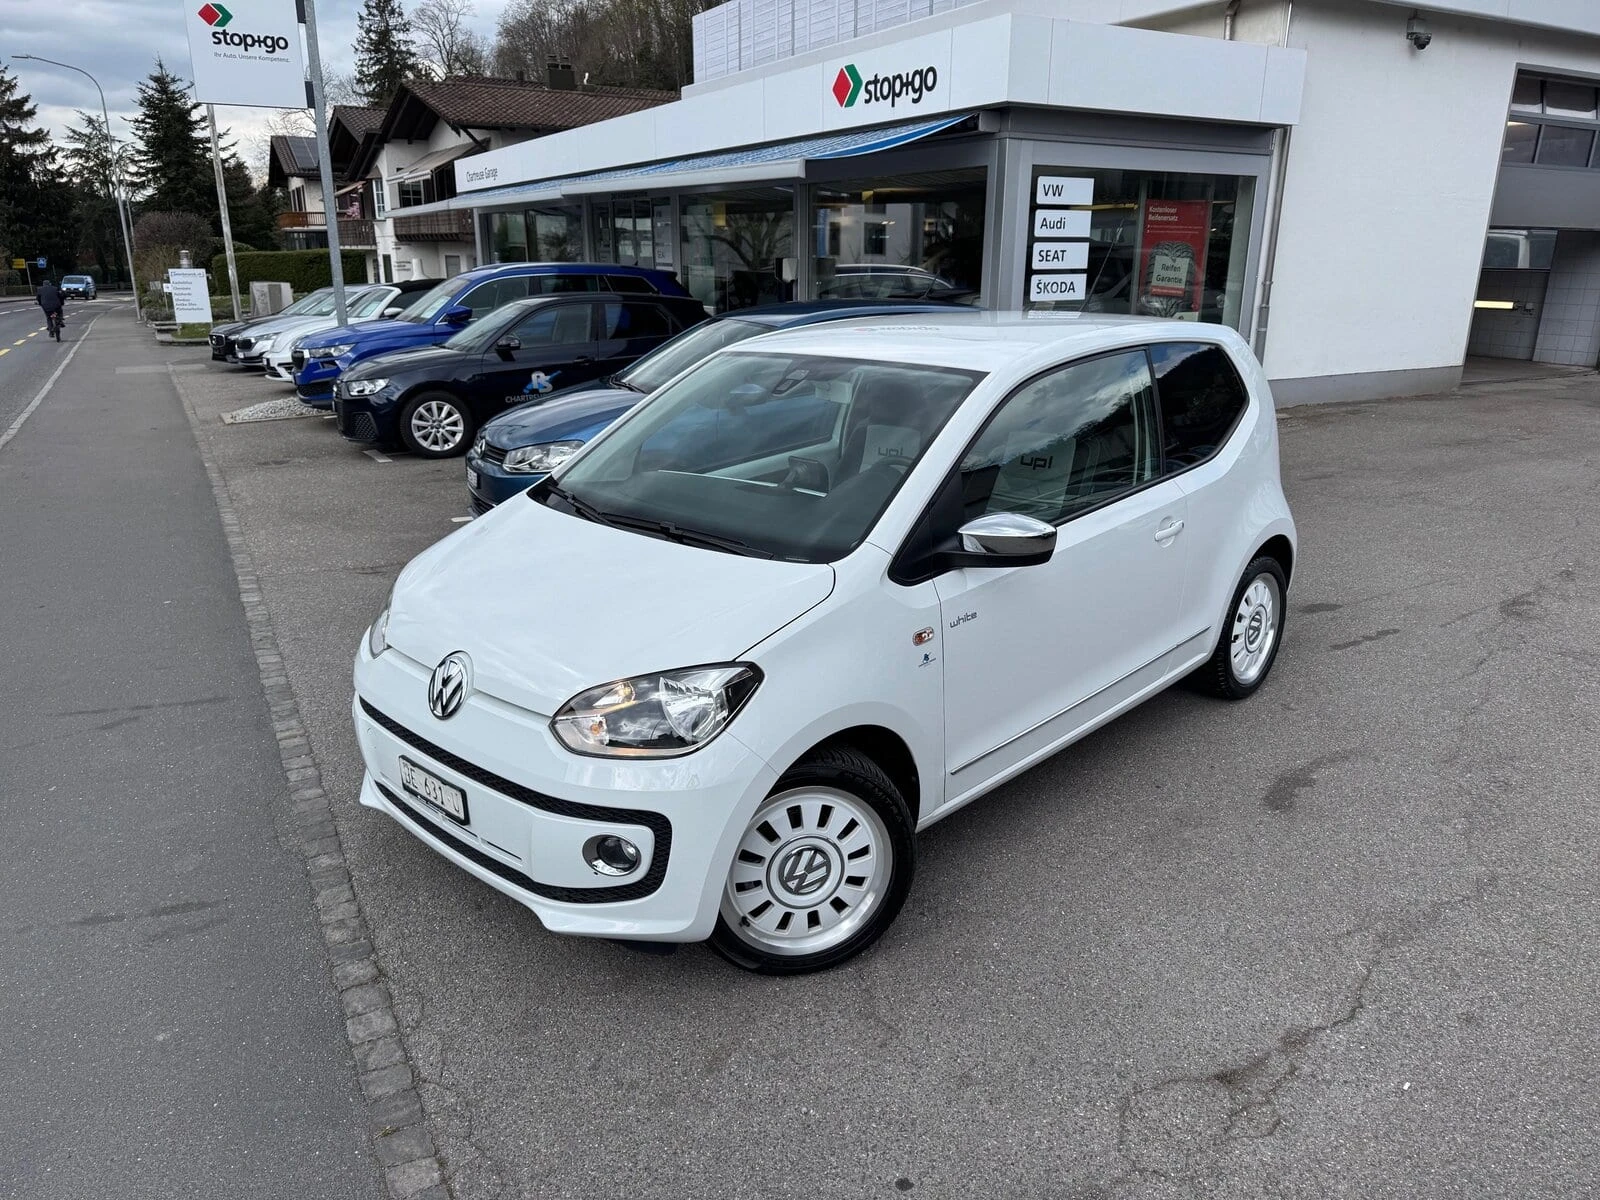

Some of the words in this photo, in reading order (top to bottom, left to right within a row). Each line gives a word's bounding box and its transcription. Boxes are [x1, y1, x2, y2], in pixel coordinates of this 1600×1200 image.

[212, 29, 288, 53] stop+go
[864, 66, 937, 108] stop+go
[1043, 183, 1064, 197] VW
[1040, 216, 1066, 230] Audi
[1038, 249, 1067, 263] SEAT
[1161, 263, 1181, 273] Reifen
[1155, 274, 1183, 284] Garantie
[1035, 279, 1076, 295] ŠKODA
[1020, 455, 1054, 470] up!
[949, 611, 978, 629] white
[424, 776, 445, 806] 631
